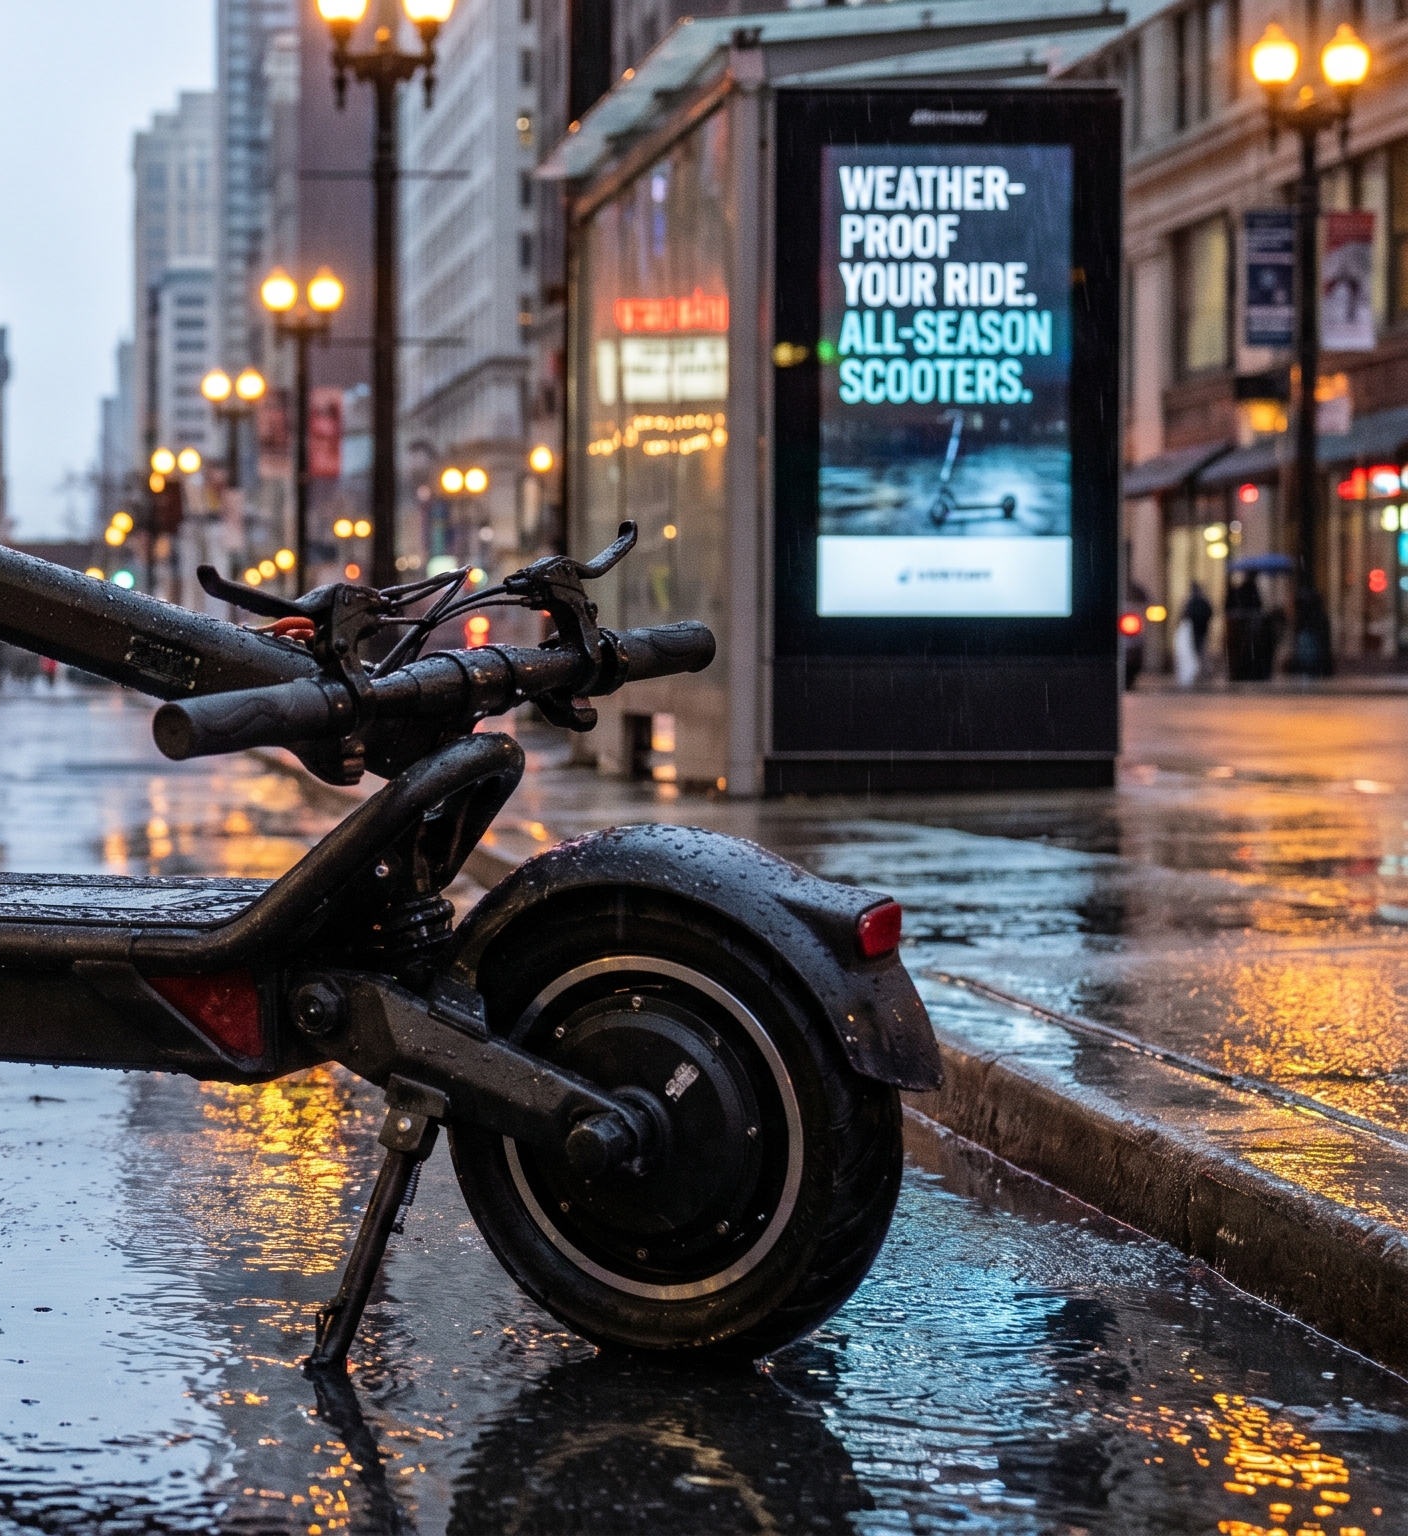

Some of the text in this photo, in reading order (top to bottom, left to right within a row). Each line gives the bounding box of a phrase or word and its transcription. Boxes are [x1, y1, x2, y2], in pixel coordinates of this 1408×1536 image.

[839, 166, 1026, 211] WEATHER-
[840, 214, 960, 259] PROOF
[839, 261, 1038, 307] YOUR RIDE.
[838, 309, 1053, 355] ALL-SEASON
[839, 358, 1033, 404] SCOOTERS.
